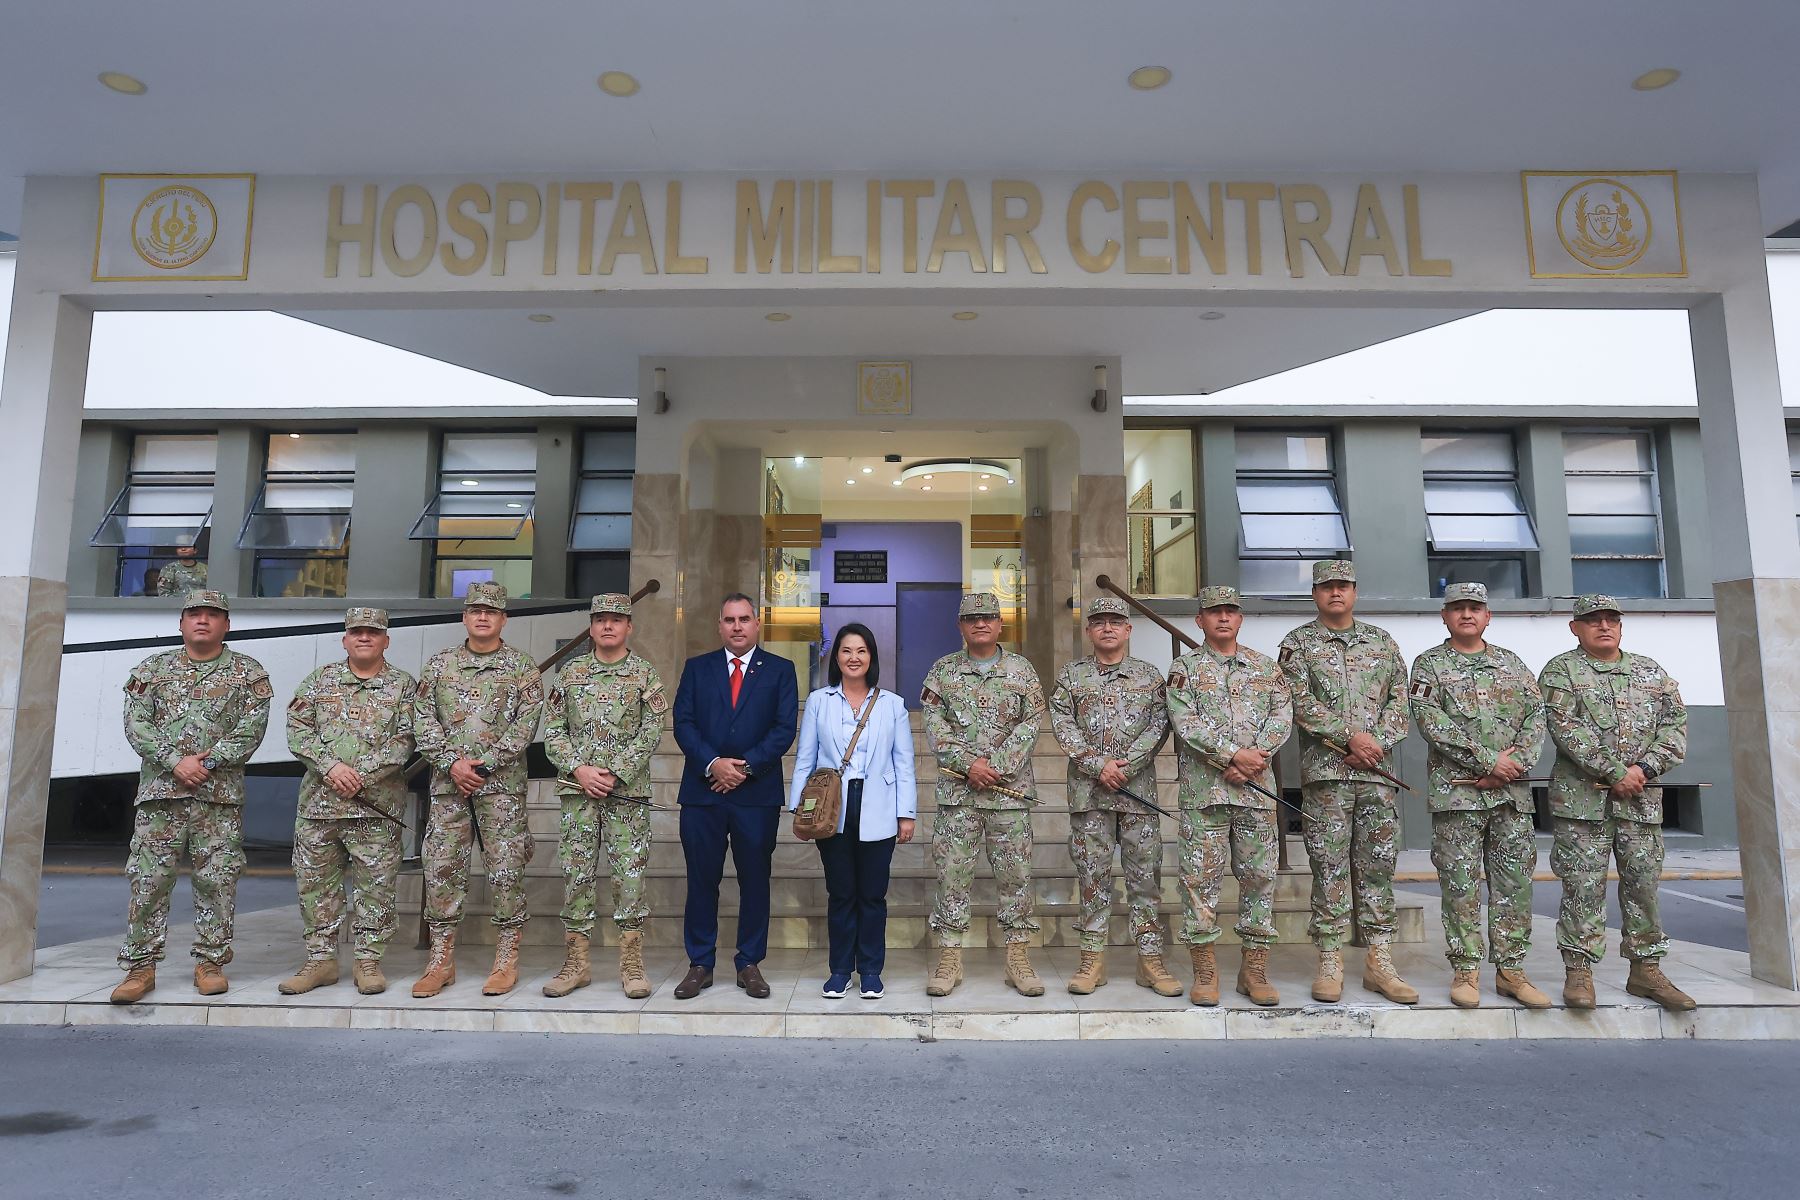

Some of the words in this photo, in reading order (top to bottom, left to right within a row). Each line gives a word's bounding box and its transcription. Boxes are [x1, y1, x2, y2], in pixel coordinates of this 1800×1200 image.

[324, 180, 709, 278] HOSPITAL
[734, 179, 1048, 274] MILITAR
[1066, 180, 1452, 278] CENTRAL
